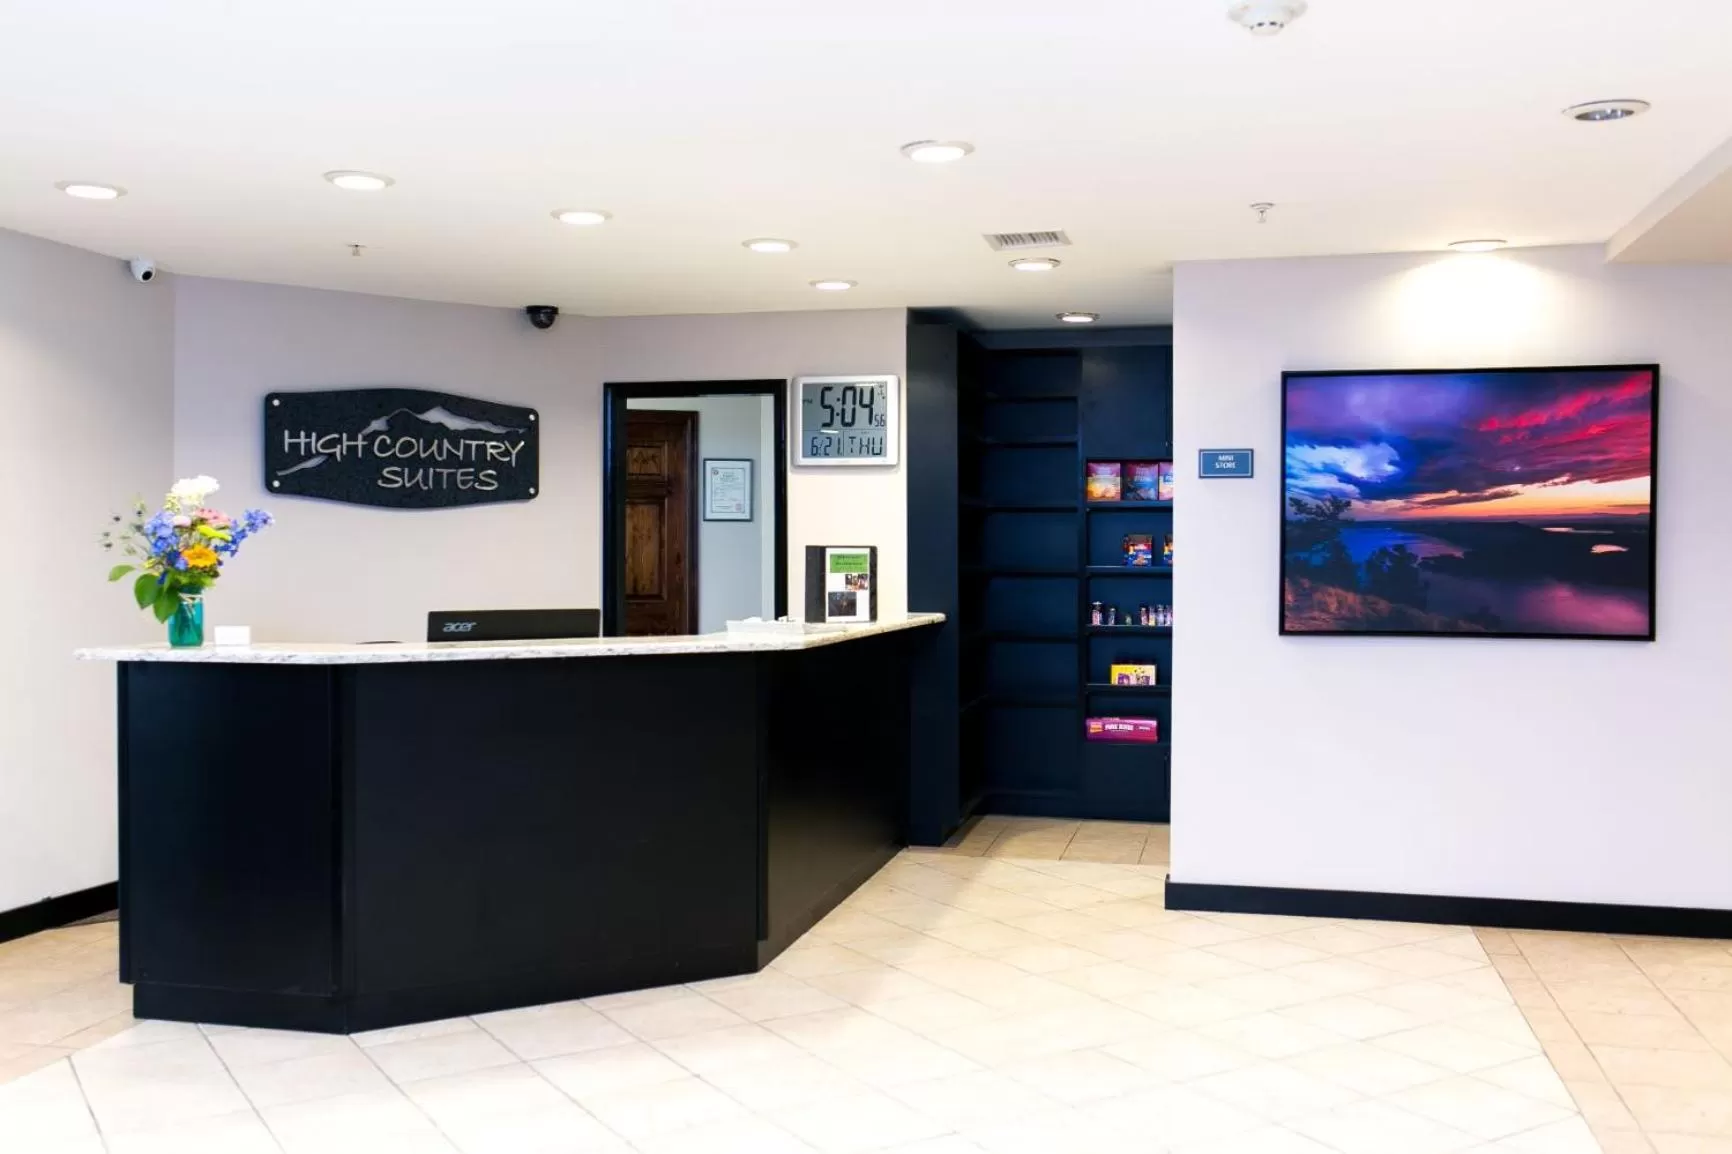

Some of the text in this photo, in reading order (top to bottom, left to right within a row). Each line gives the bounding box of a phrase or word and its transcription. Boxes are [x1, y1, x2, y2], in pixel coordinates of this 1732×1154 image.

[820, 386, 875, 427] 5:04
[284, 430, 525, 467] HIGH COUNTRY
[849, 436, 883, 456] THU
[377, 466, 499, 491] SUITES
[442, 622, 477, 632] acer
